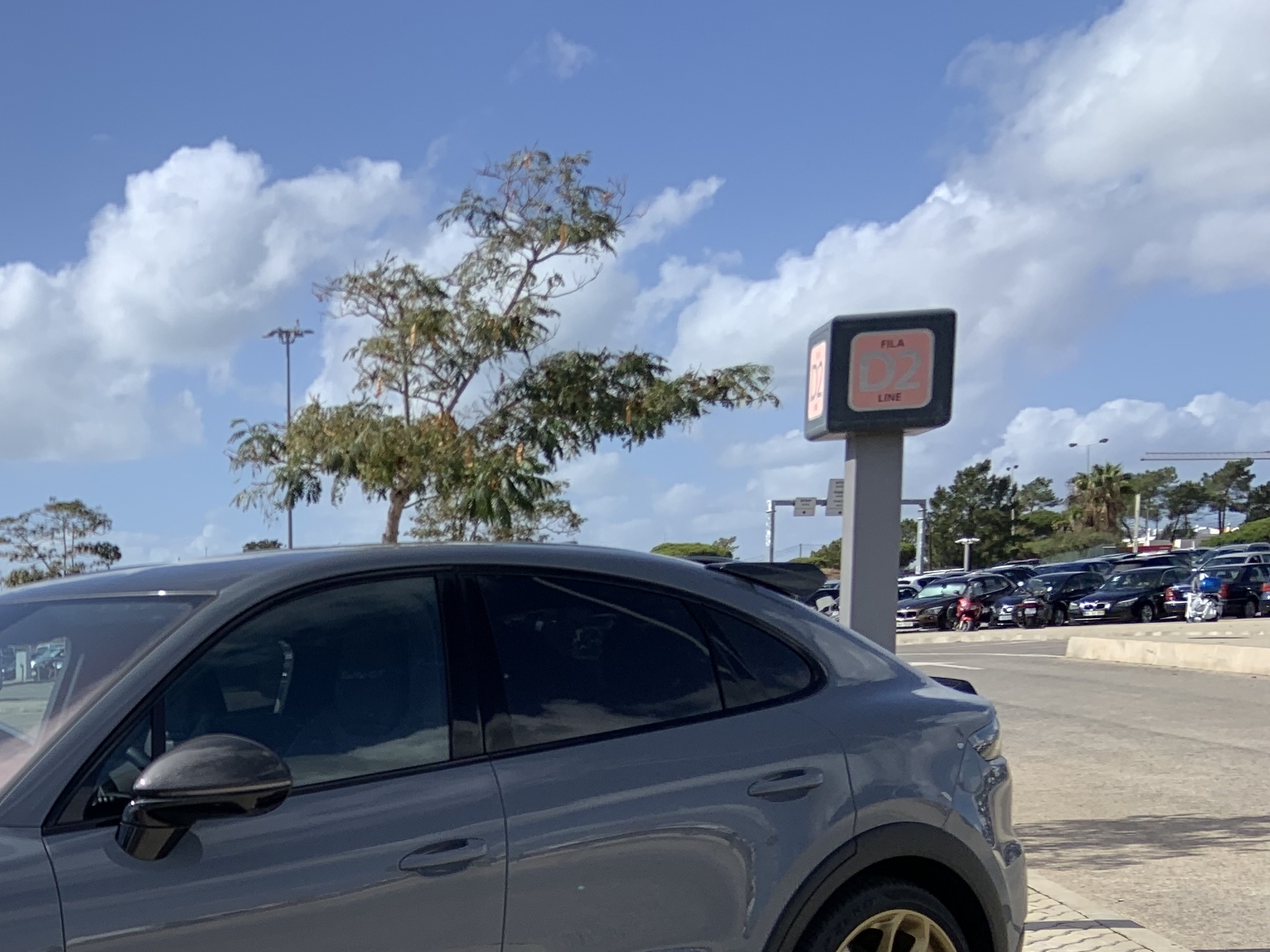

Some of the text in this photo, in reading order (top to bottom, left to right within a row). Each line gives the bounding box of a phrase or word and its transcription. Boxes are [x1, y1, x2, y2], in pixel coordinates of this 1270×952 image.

[880, 339, 905, 349] FILA
[859, 350, 922, 392] D2
[877, 392, 902, 403] LINE
